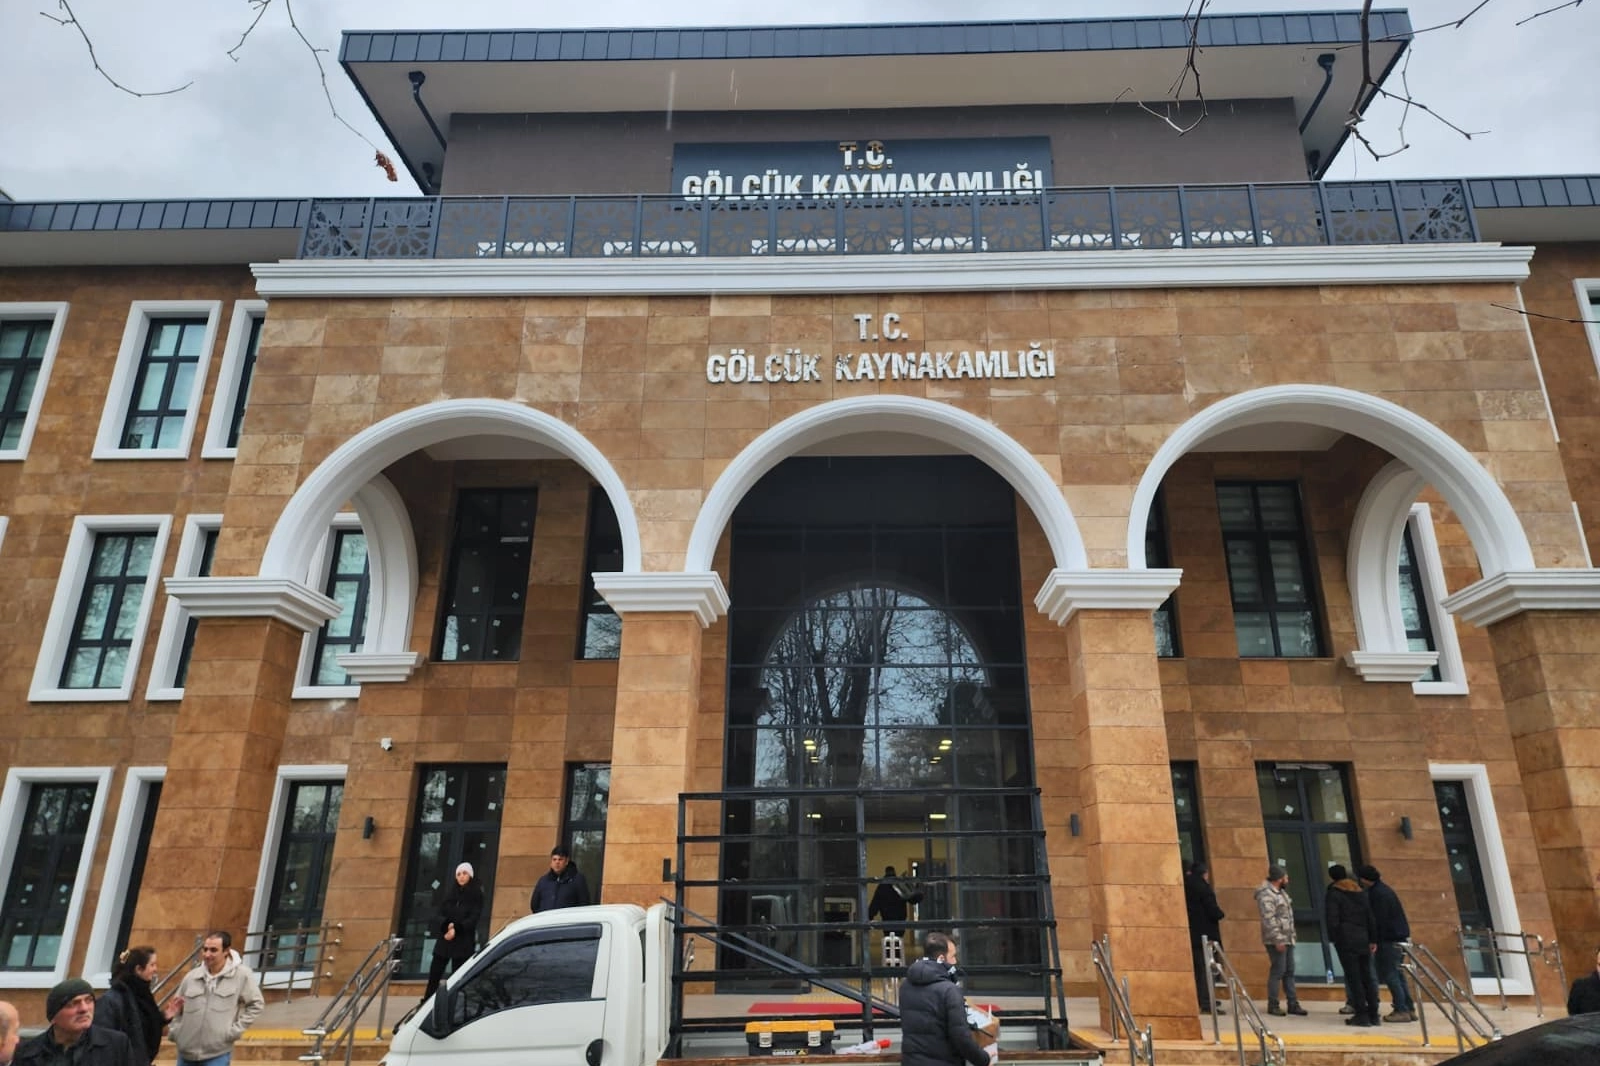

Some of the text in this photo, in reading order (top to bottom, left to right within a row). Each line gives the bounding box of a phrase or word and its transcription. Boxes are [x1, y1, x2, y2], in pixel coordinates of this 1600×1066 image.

[840, 140, 893, 168] T.C.
[682, 162, 1042, 201] GÖLCÜK KAYMAKAMLIĞI
[853, 312, 909, 341] T.C.
[706, 341, 1056, 383] GÖLCÜK KAYMAKAMLIĞI
